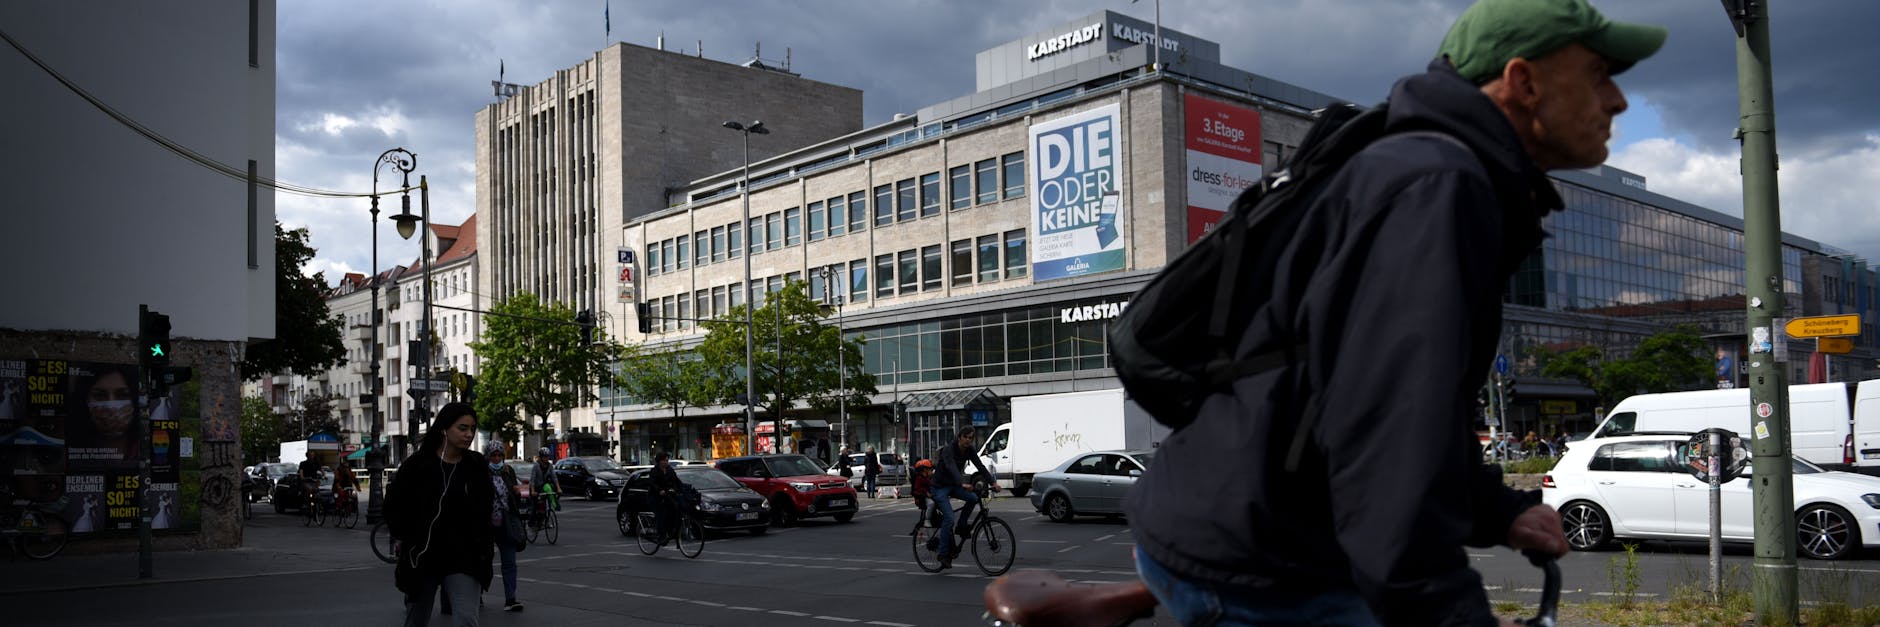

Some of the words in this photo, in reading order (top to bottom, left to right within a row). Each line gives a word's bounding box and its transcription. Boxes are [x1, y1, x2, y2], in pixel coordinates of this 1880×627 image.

[1028, 23, 1101, 59] KARSTADT
[1203, 118, 1213, 133] 3.
[1214, 120, 1245, 142] Etage
[1039, 120, 1111, 181] DIE
[1040, 169, 1111, 209] ODER
[1041, 201, 1101, 231] KEINE
[1803, 327, 1843, 335] Kreuzberg
[47, 361, 68, 375] ES!
[28, 376, 47, 391] SO
[31, 393, 65, 406] NICHT!
[66, 475, 104, 483] BERLINER
[66, 484, 104, 492] ENSEMBLE
[106, 491, 124, 506] SO
[109, 507, 140, 518] NICHT!
